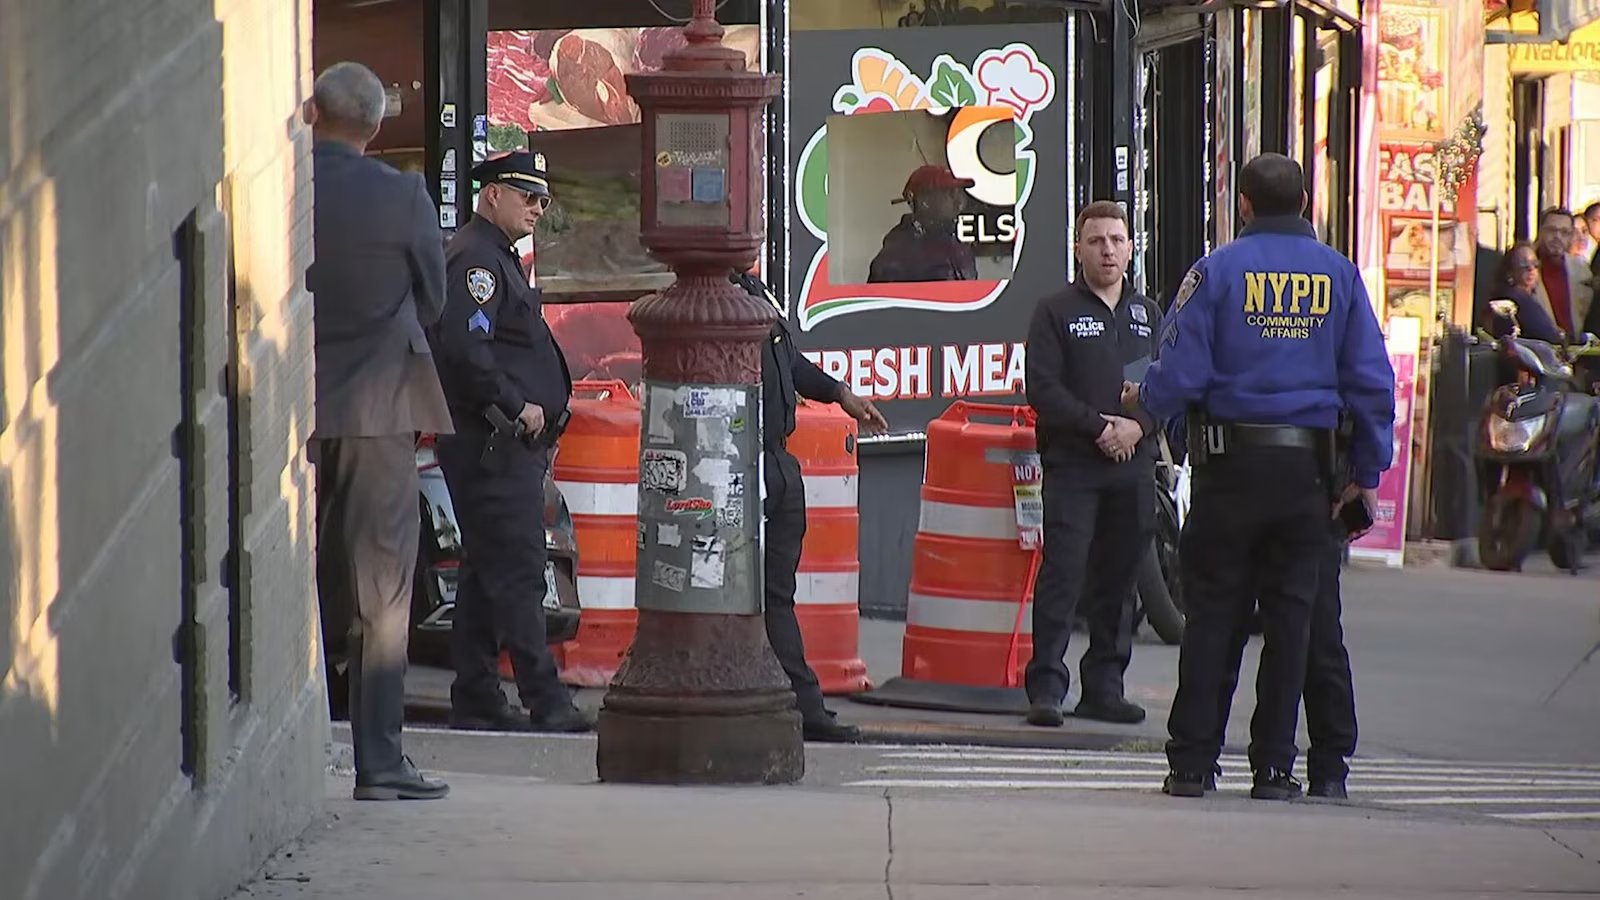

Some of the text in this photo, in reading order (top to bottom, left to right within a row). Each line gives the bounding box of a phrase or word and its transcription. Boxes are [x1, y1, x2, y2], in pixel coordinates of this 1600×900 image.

[1244, 272, 1331, 315] NYPD
[1069, 321, 1105, 333] POLICE
[1247, 315, 1324, 328] COMMUNITY
[1261, 327, 1309, 339] AFFAIRS
[1015, 465, 1032, 481] NO
